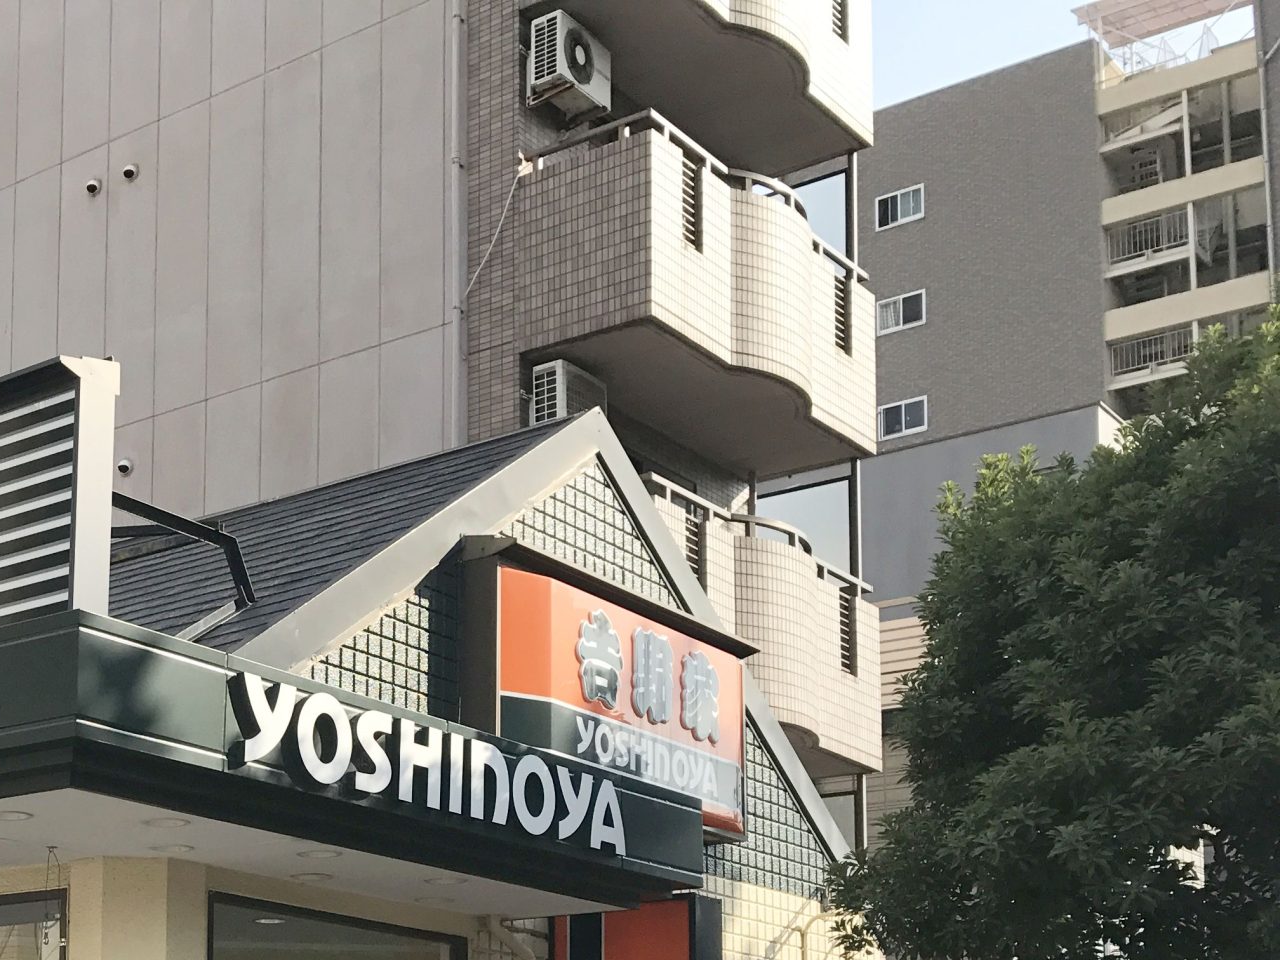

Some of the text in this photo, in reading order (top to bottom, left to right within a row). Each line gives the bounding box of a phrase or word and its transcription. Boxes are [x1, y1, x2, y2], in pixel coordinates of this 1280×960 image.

[576, 608, 720, 745] 吉野家
[242, 671, 627, 856] YOSHINOYA
[575, 715, 719, 798] YOSHINOYA
